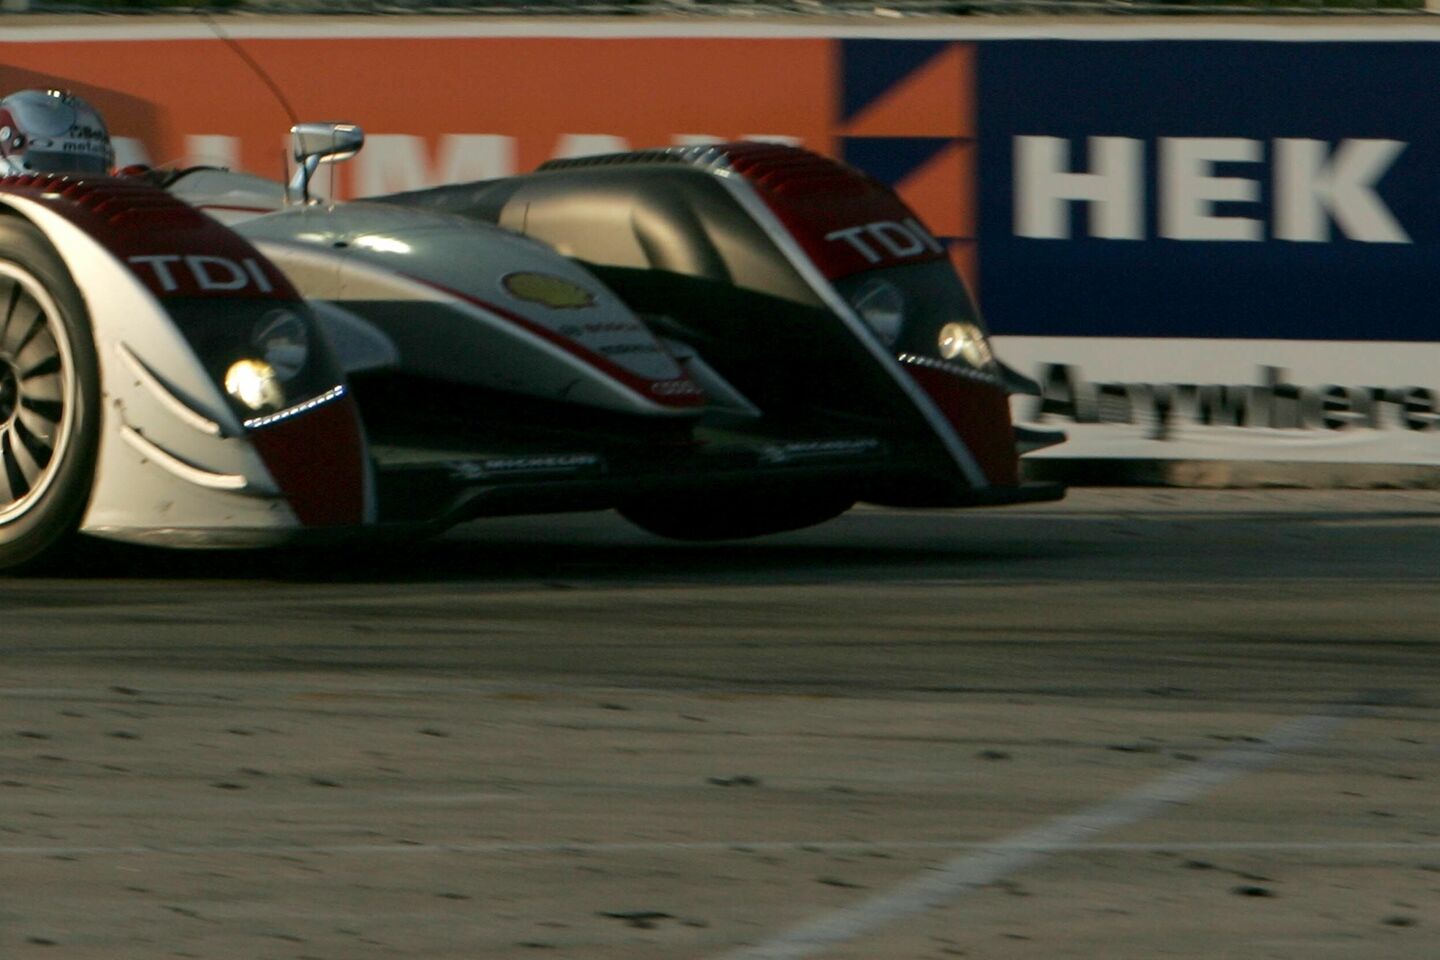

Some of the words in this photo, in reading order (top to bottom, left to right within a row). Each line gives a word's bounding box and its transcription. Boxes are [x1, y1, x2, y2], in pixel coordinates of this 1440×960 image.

[1012, 135, 1413, 243] HEK
[824, 218, 944, 263] TDI
[128, 254, 273, 293] TDI
[1030, 362, 1440, 440] Anywhere
